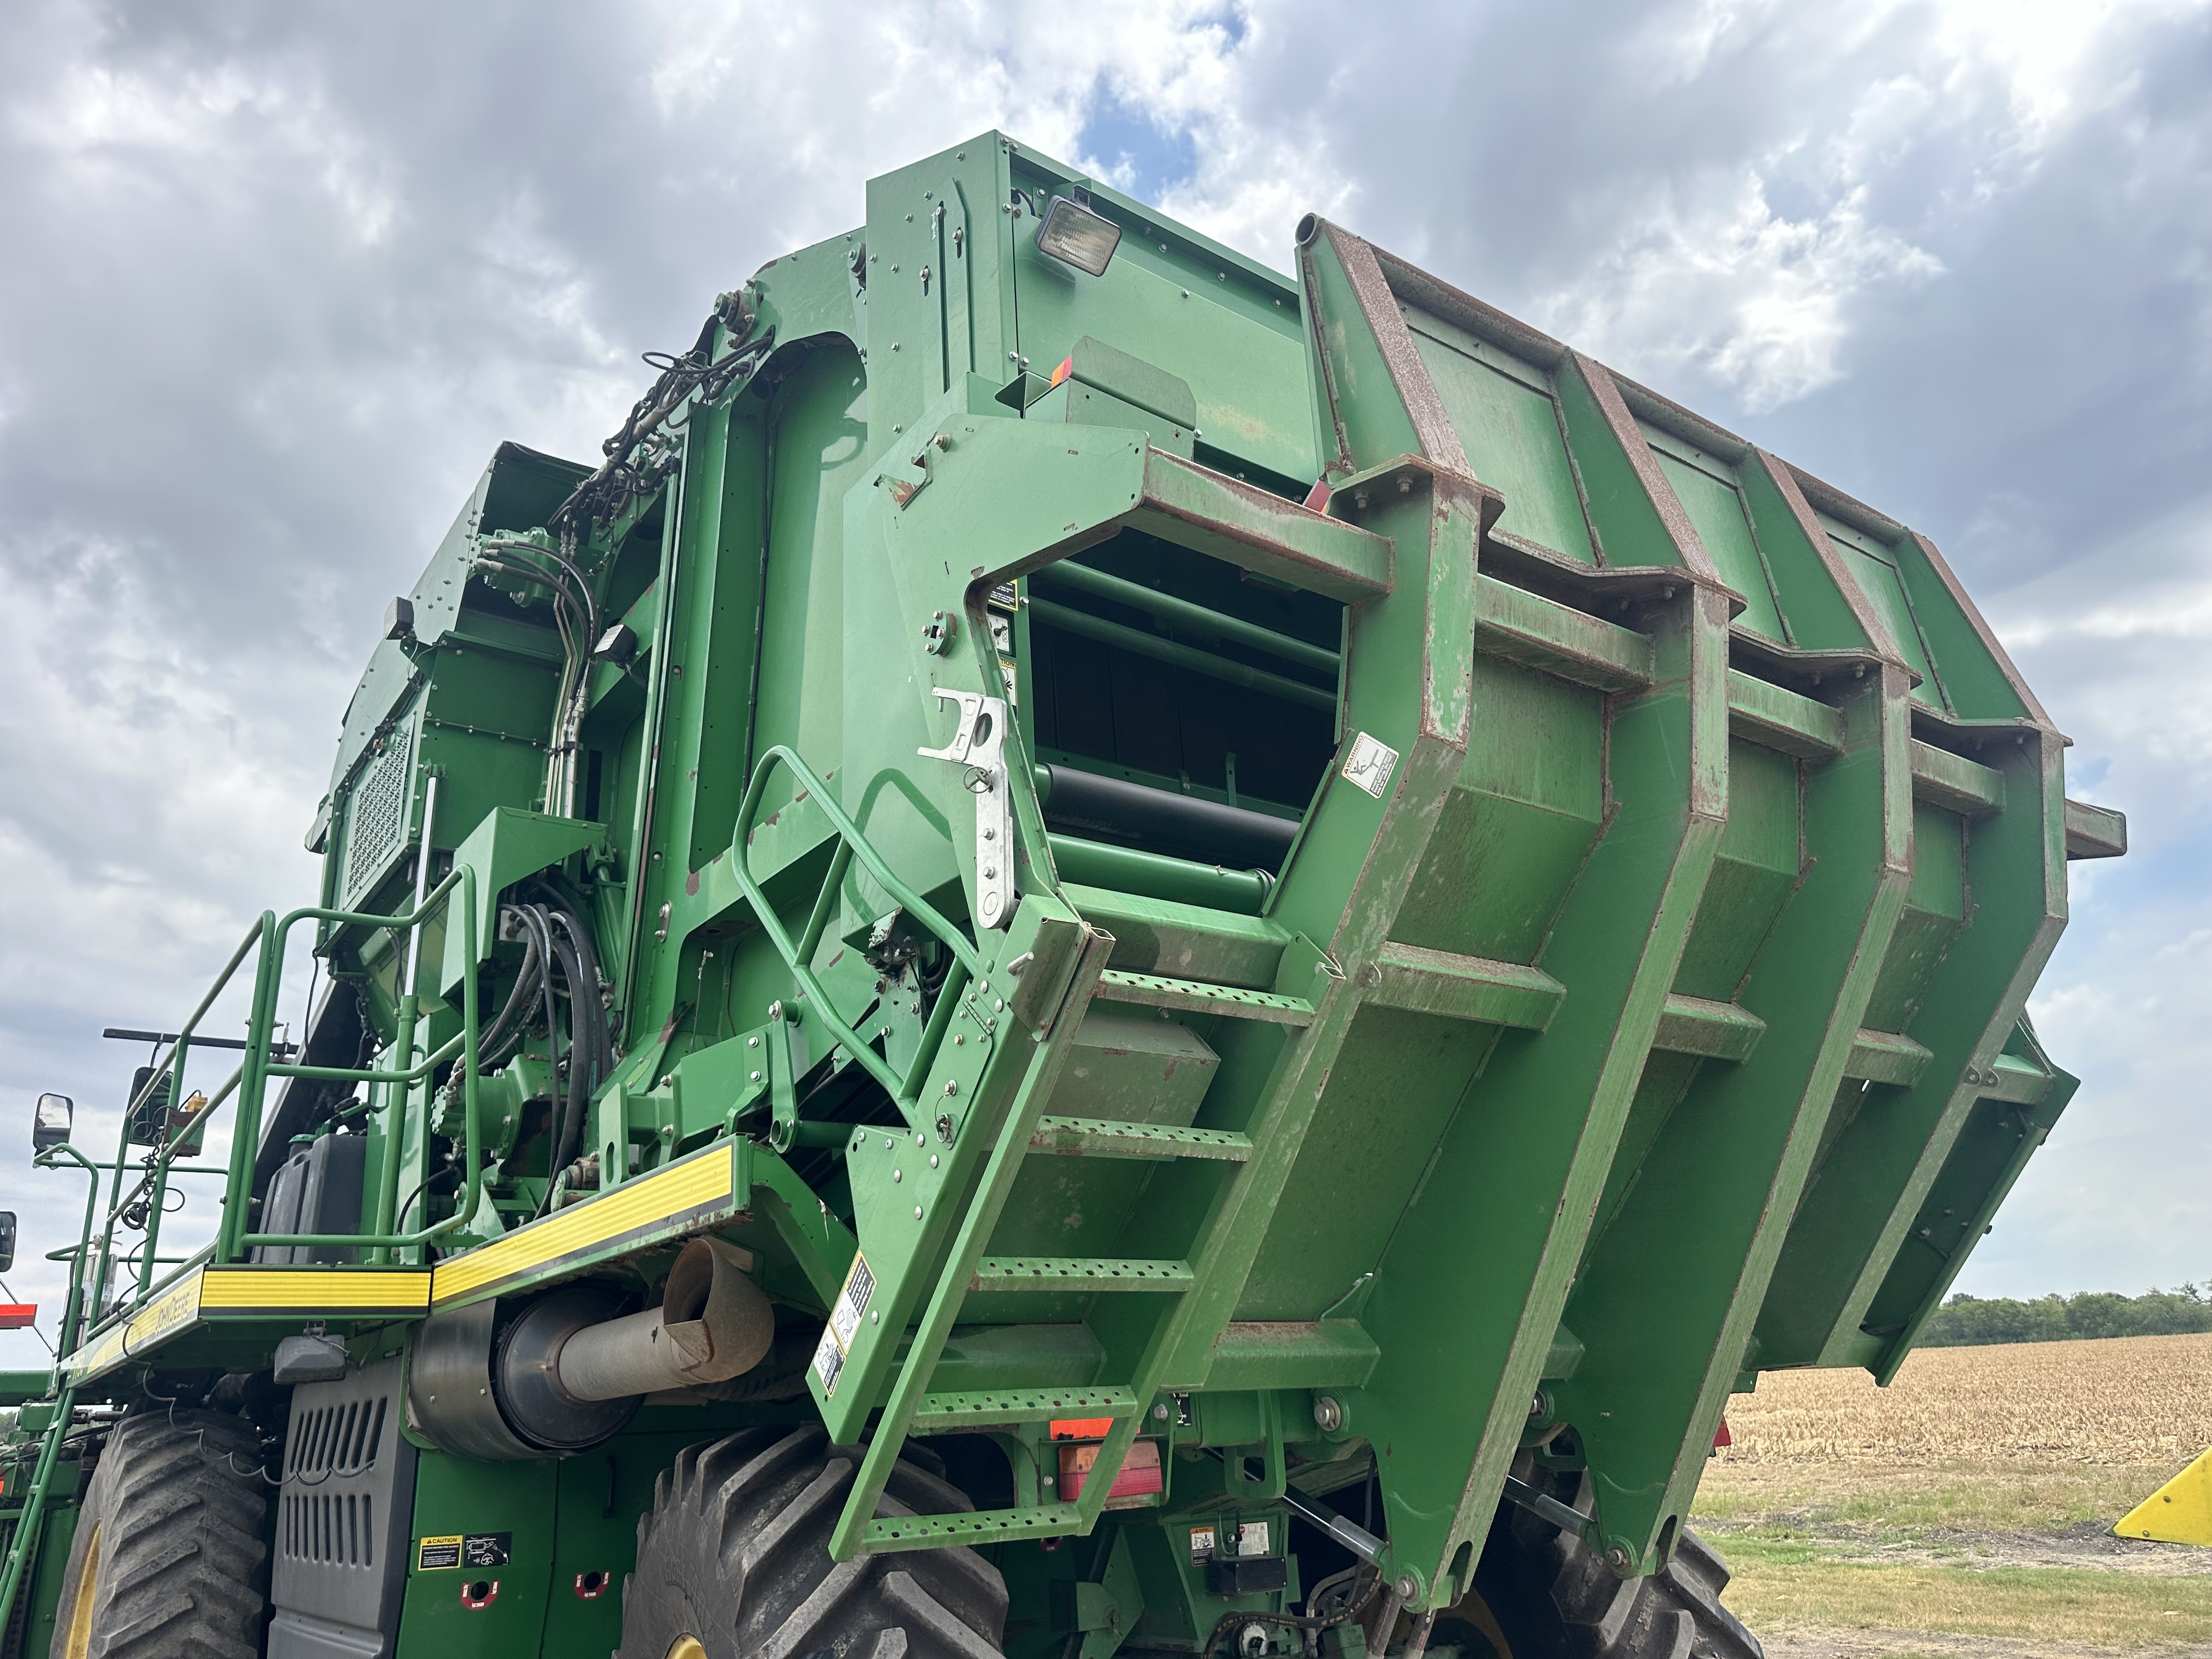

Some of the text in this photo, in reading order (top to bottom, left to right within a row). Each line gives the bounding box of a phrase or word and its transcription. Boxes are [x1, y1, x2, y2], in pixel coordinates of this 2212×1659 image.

[1000, 658, 1014, 667] TION
[1347, 735, 1363, 768] WARNING
[155, 1291, 190, 1333] JOHN DEERE
